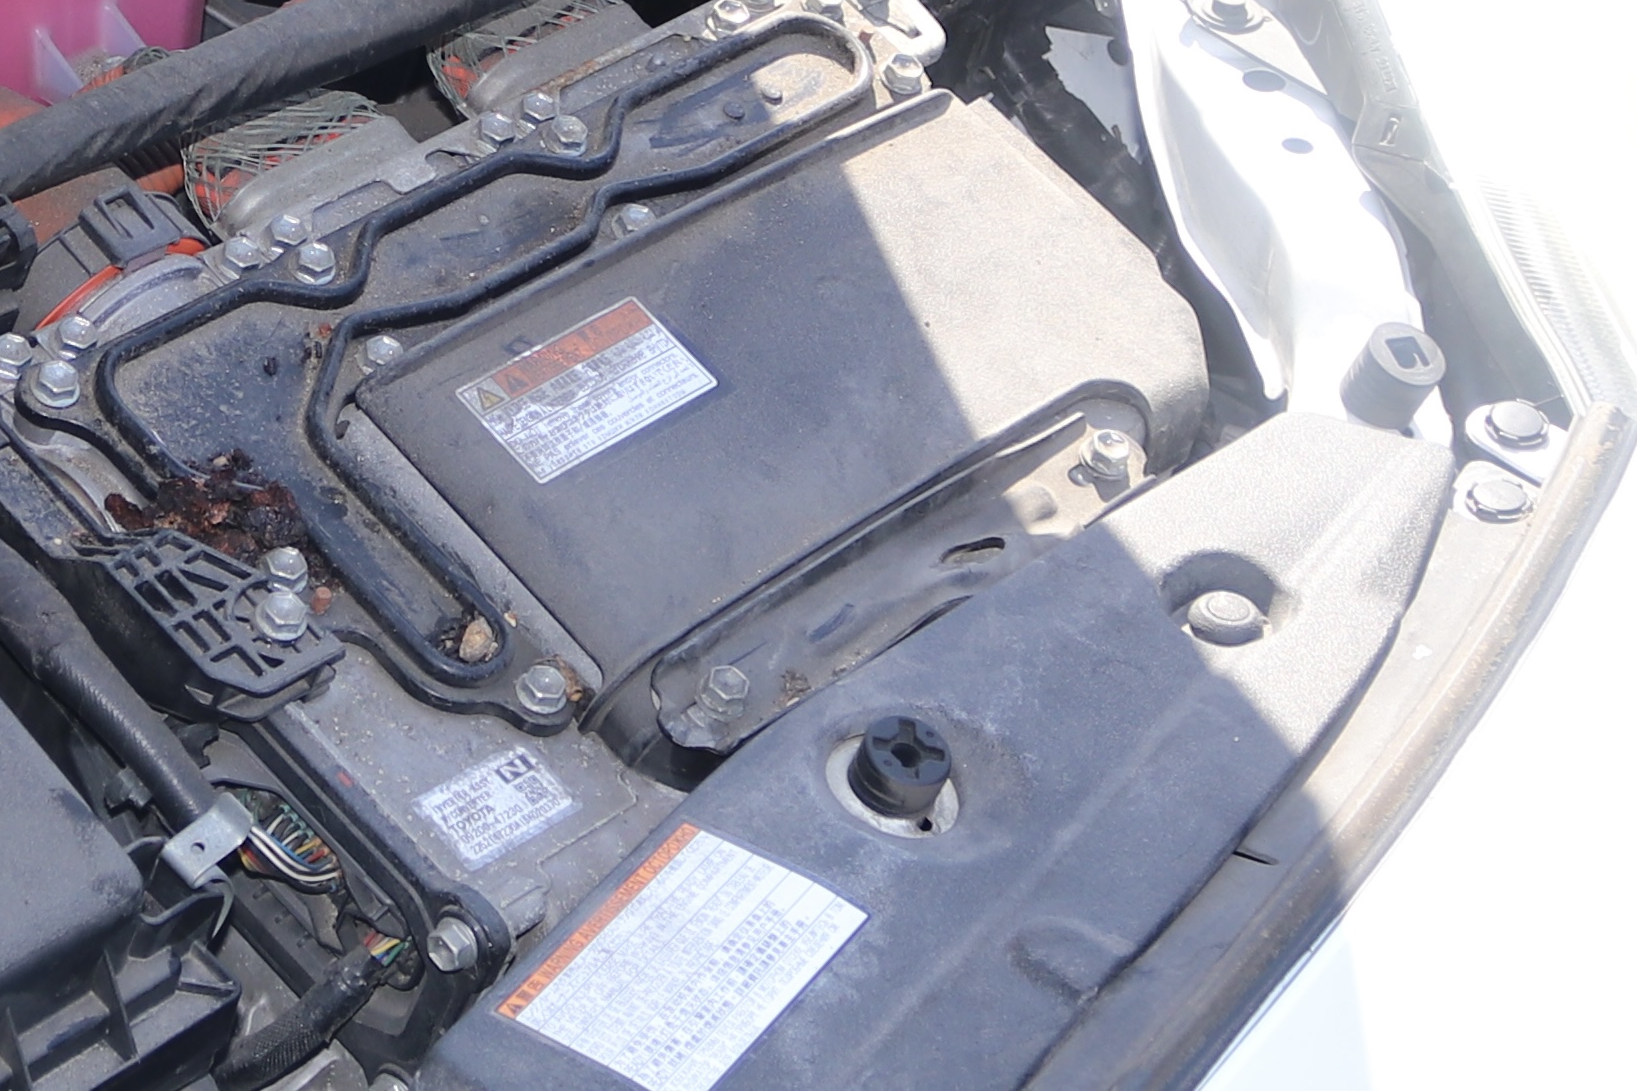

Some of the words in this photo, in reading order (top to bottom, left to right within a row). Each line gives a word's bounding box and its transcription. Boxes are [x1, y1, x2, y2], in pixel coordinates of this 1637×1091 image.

[447, 804, 495, 835] TOYOTA
[536, 936, 587, 980] WARNING
[575, 873, 650, 942] AVERTISSEMENT
